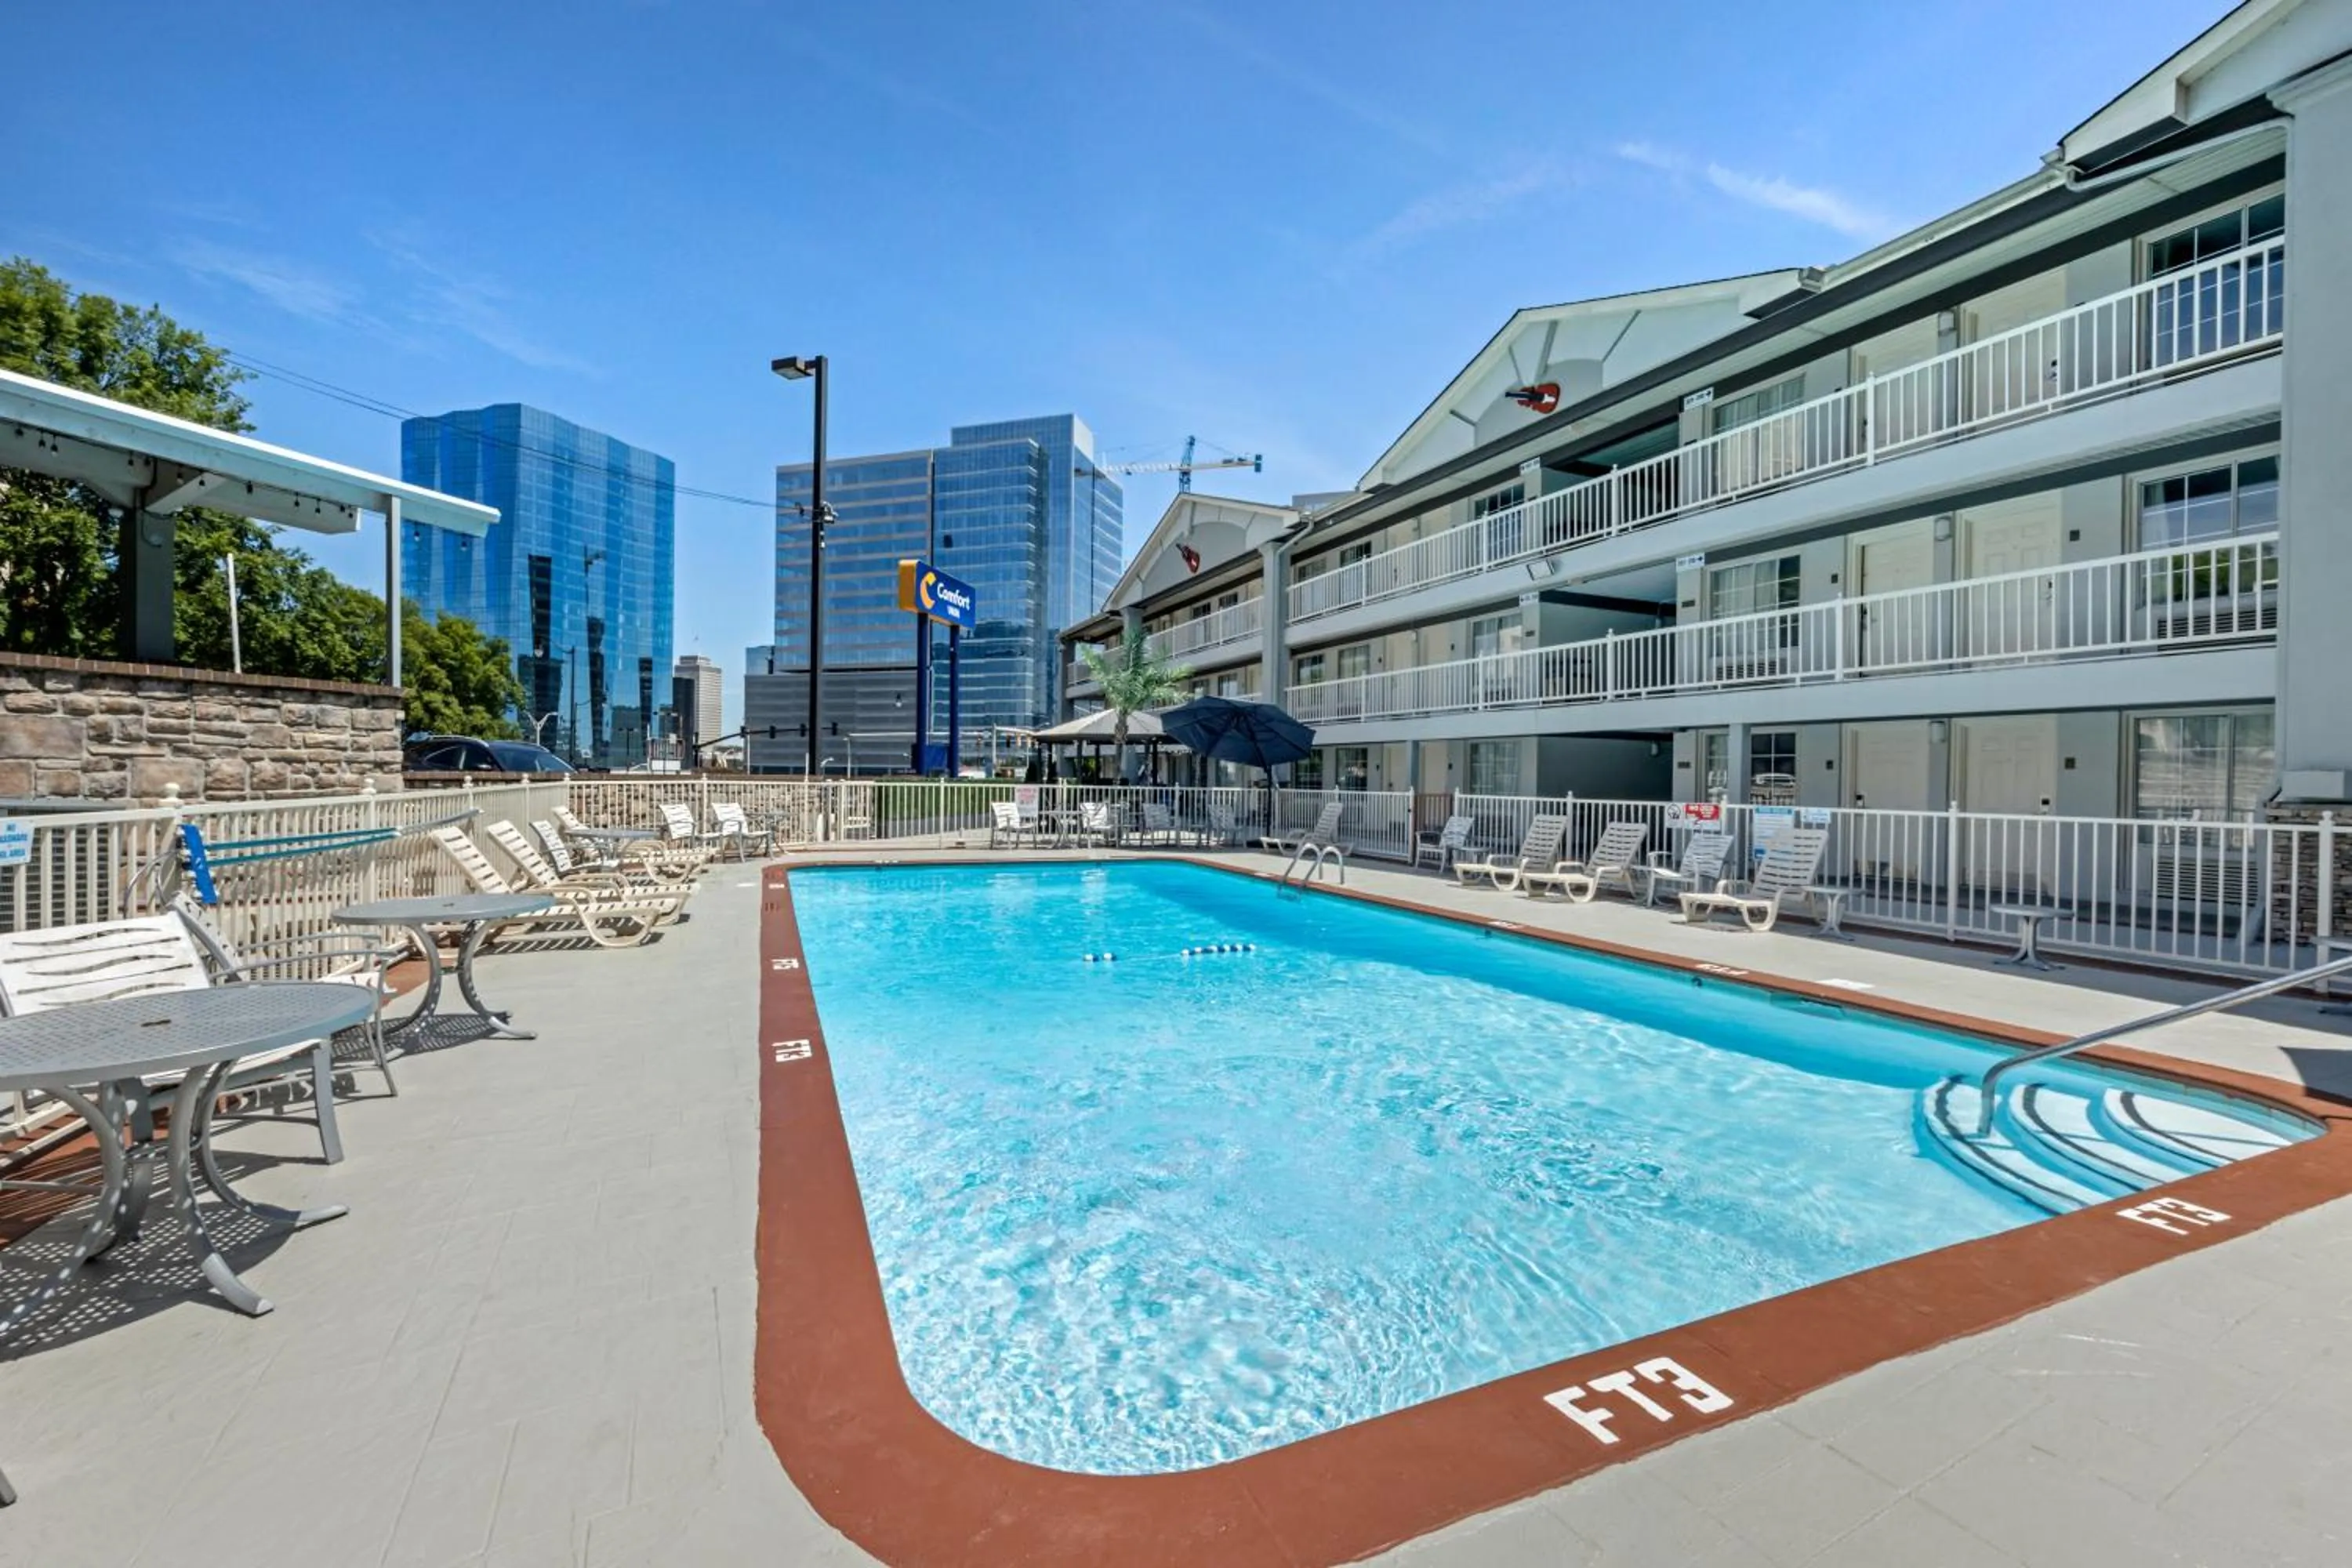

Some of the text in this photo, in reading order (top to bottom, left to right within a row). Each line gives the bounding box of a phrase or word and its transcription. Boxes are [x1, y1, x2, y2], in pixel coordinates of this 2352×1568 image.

[937, 583, 970, 611] Comfort
[2116, 1197, 2233, 1236] FT3
[1543, 1357, 1734, 1444] FT3
